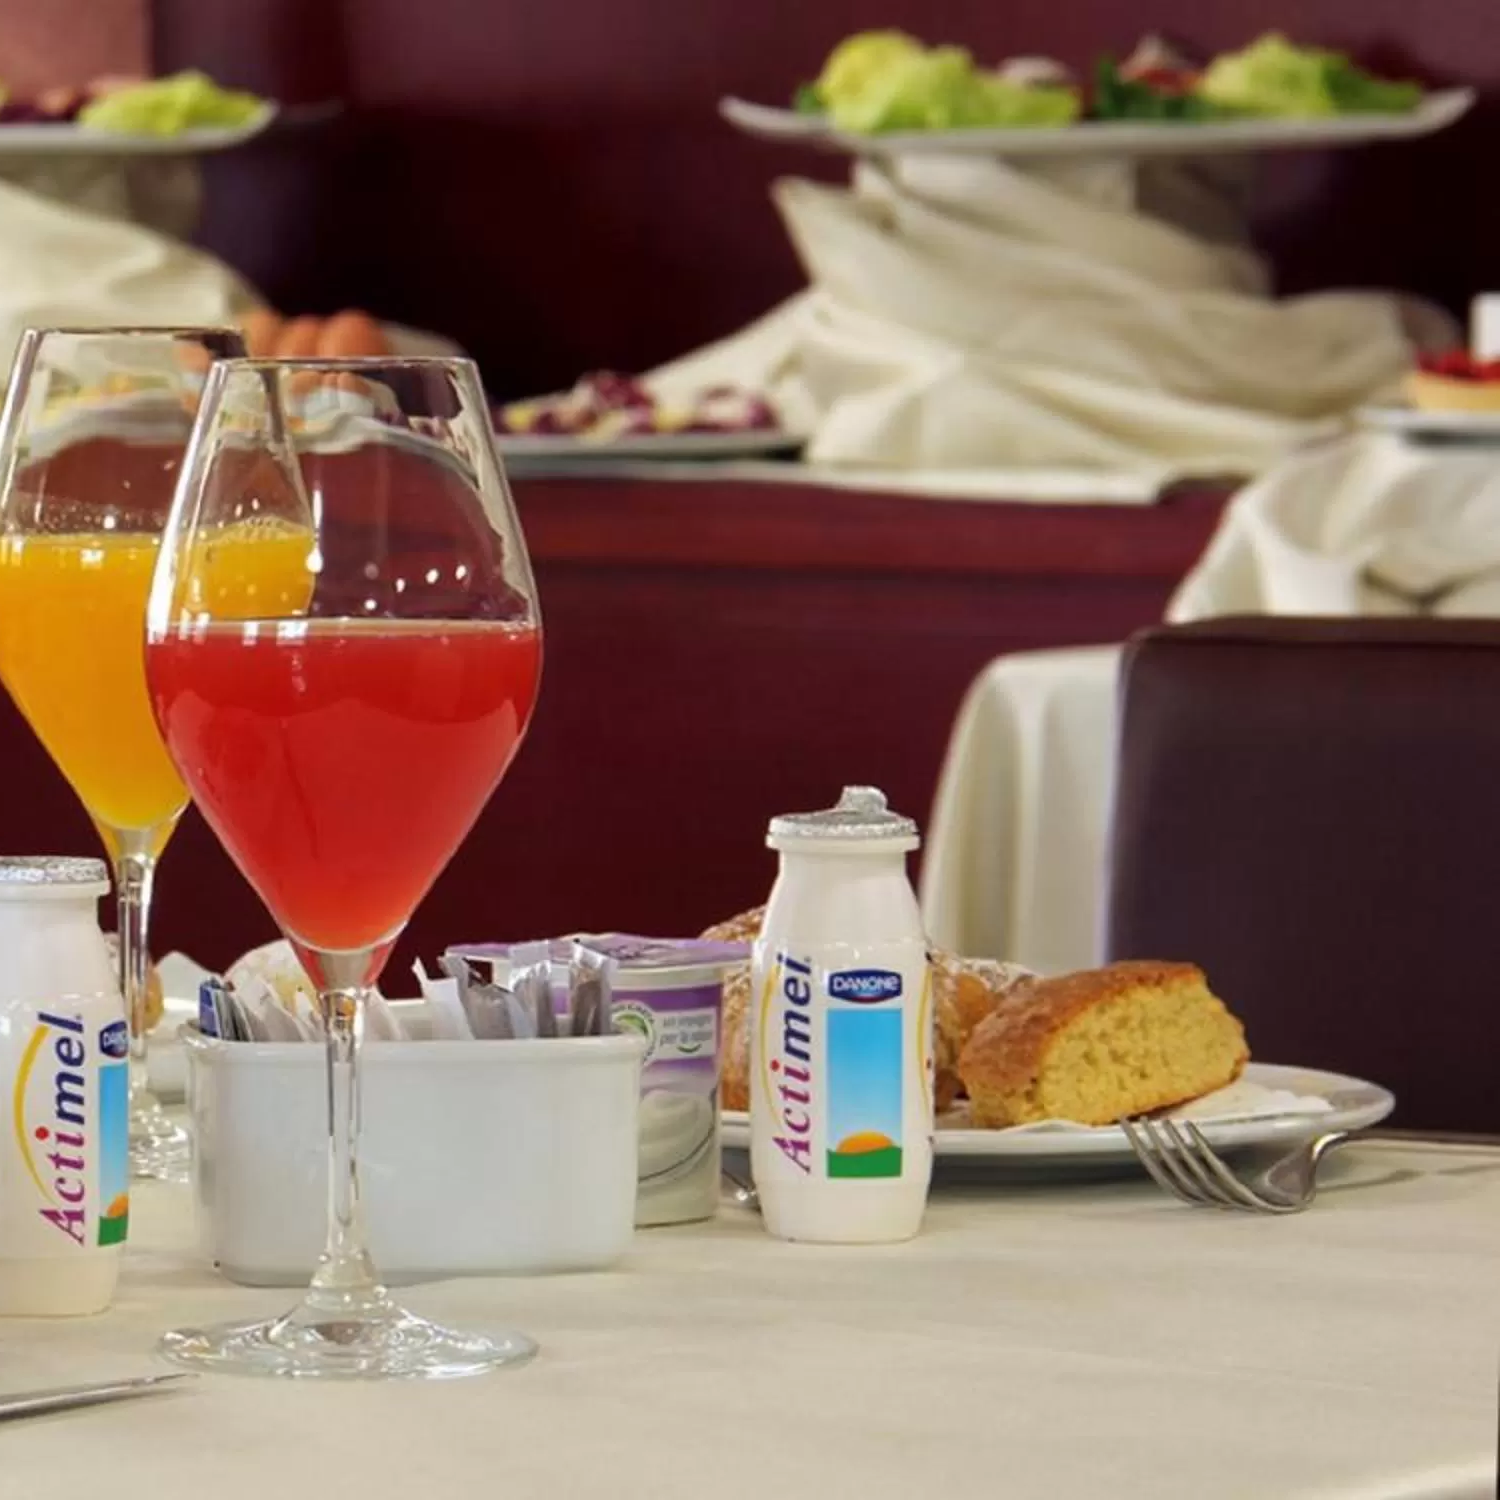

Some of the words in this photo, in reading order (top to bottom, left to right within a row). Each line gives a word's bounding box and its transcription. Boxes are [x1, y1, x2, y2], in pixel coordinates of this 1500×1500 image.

[771, 953, 812, 1175] Actimel
[833, 975, 898, 991] DANONE
[35, 1011, 86, 1247] Actimel
